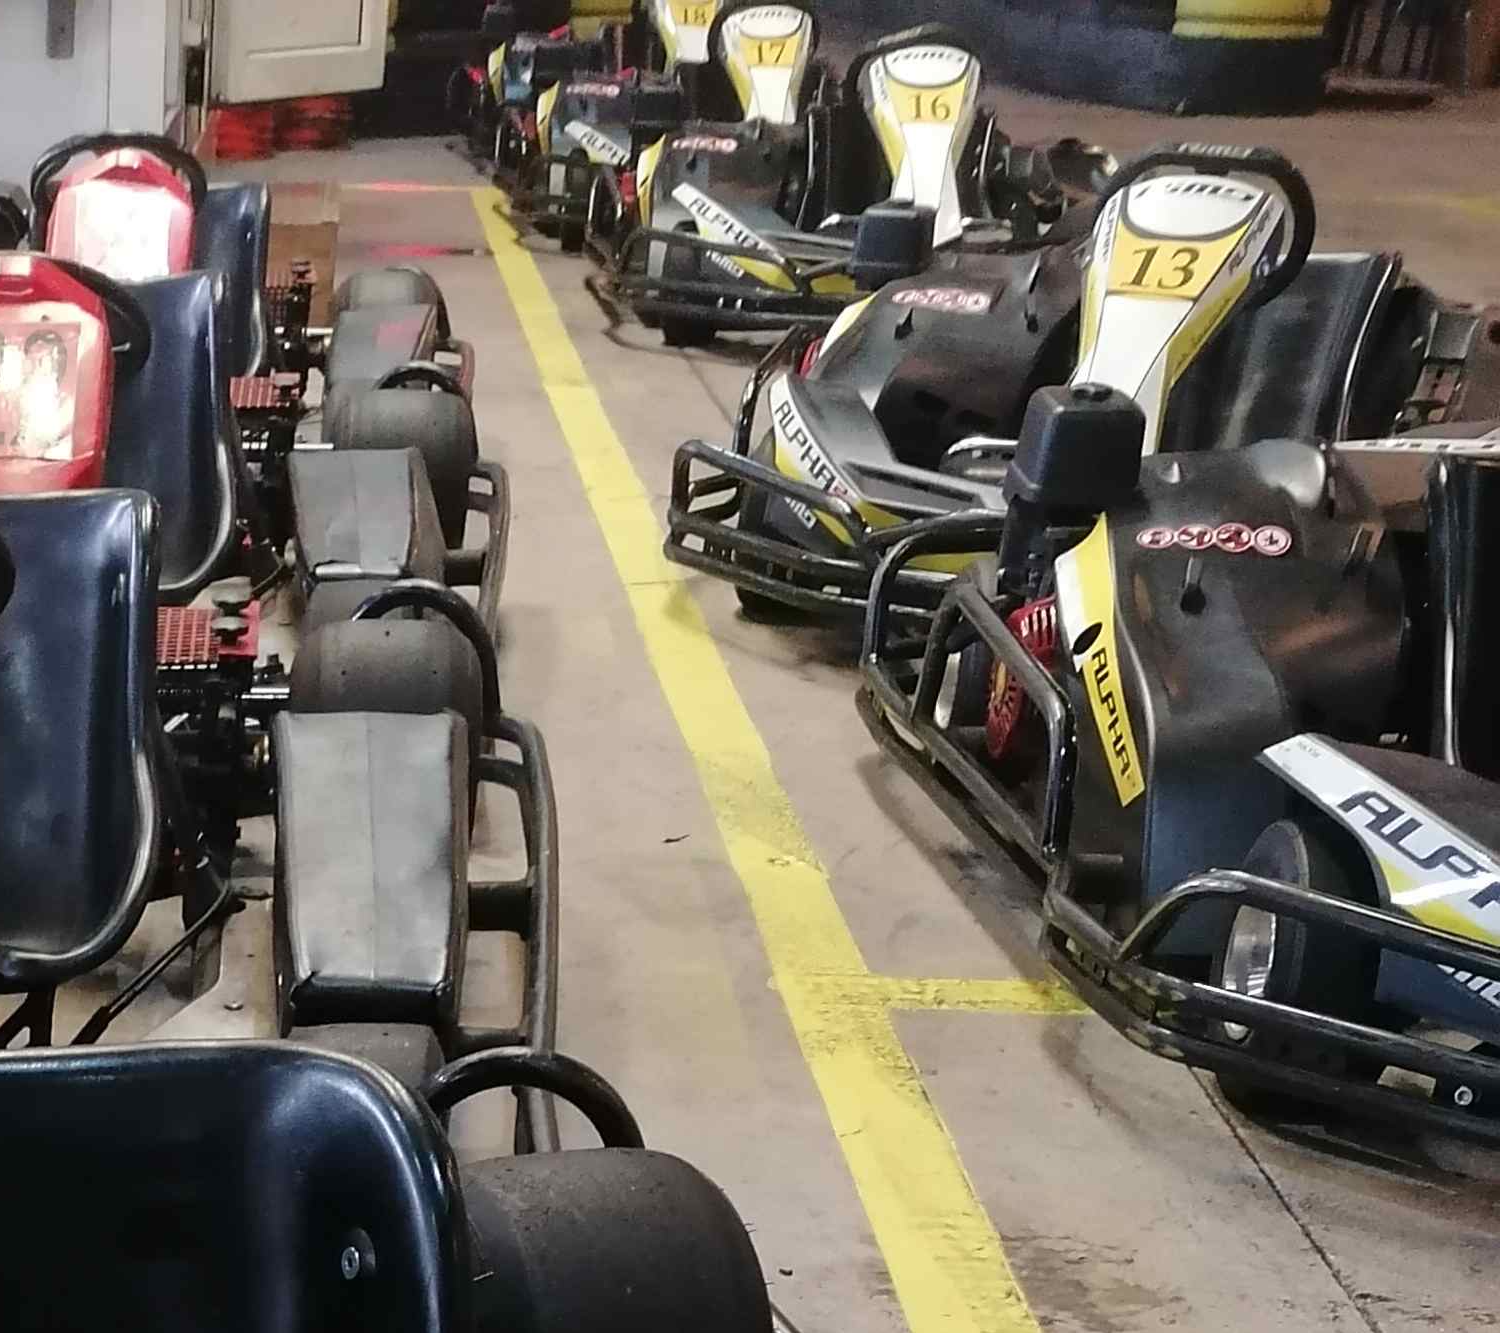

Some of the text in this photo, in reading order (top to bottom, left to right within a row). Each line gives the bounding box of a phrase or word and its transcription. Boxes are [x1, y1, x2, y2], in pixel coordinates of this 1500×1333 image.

[757, 41, 787, 64] 17
[908, 93, 951, 121] 16
[1119, 244, 1201, 290] 13
